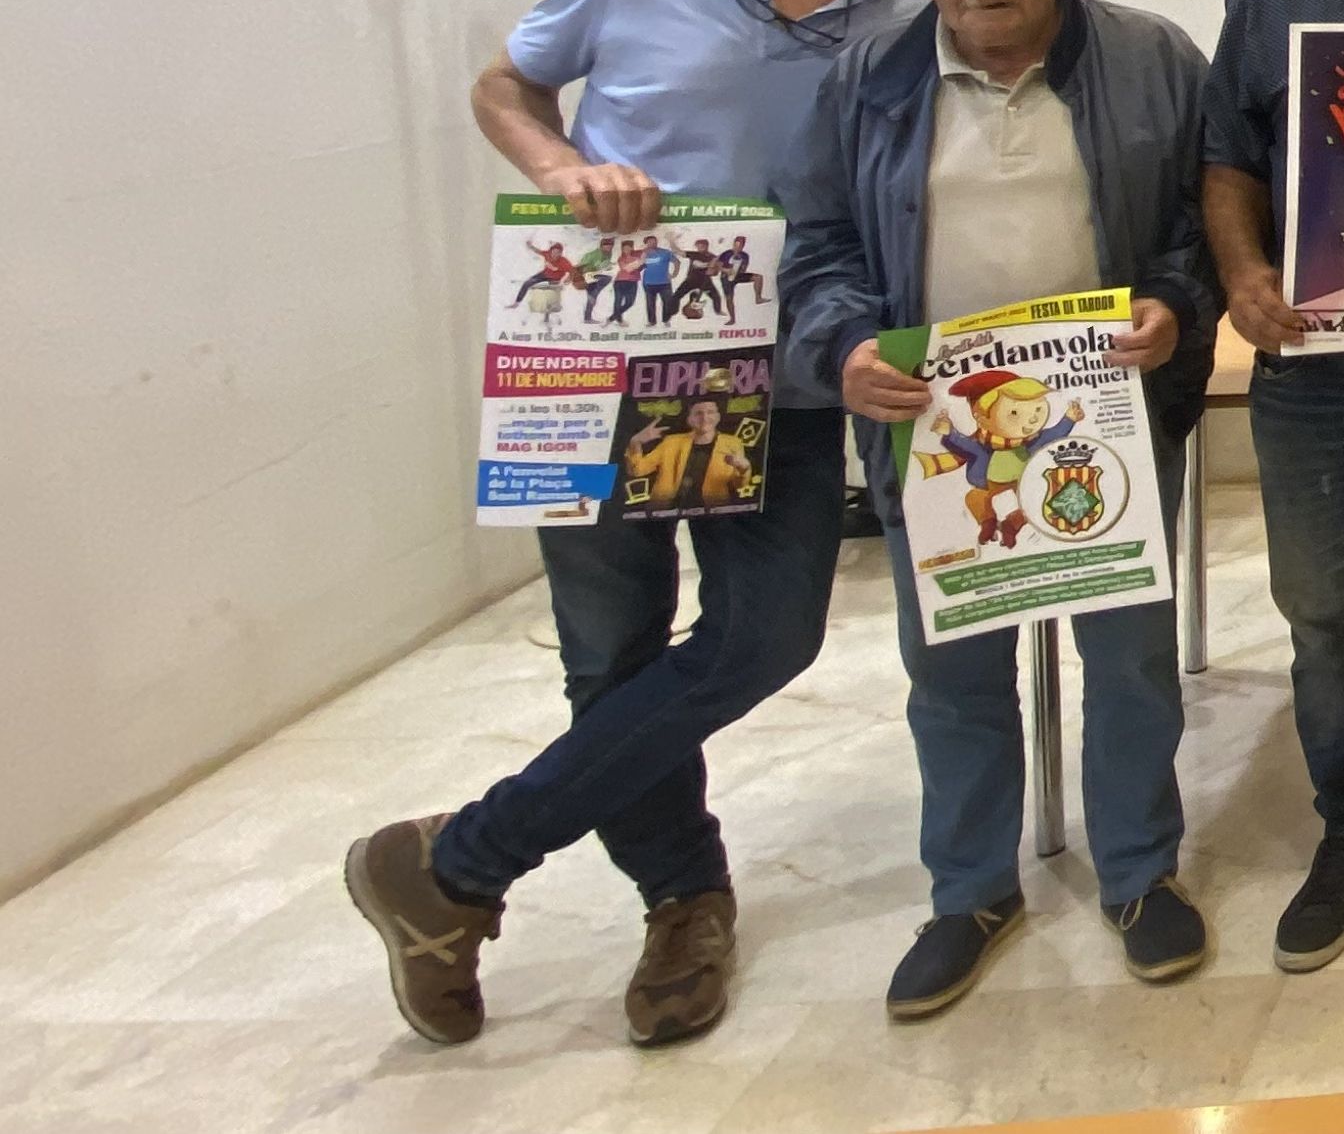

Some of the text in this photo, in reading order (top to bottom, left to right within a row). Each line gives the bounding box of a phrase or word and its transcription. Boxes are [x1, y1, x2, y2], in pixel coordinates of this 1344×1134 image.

[1030, 299, 1061, 319] FESTA
[498, 331, 508, 341] A
[719, 328, 767, 339] RIKUS
[496, 356, 618, 369] DIVENDRES
[497, 372, 617, 387] 11 DE NOVEMBRE
[496, 442, 577, 452] MAG IGOR
